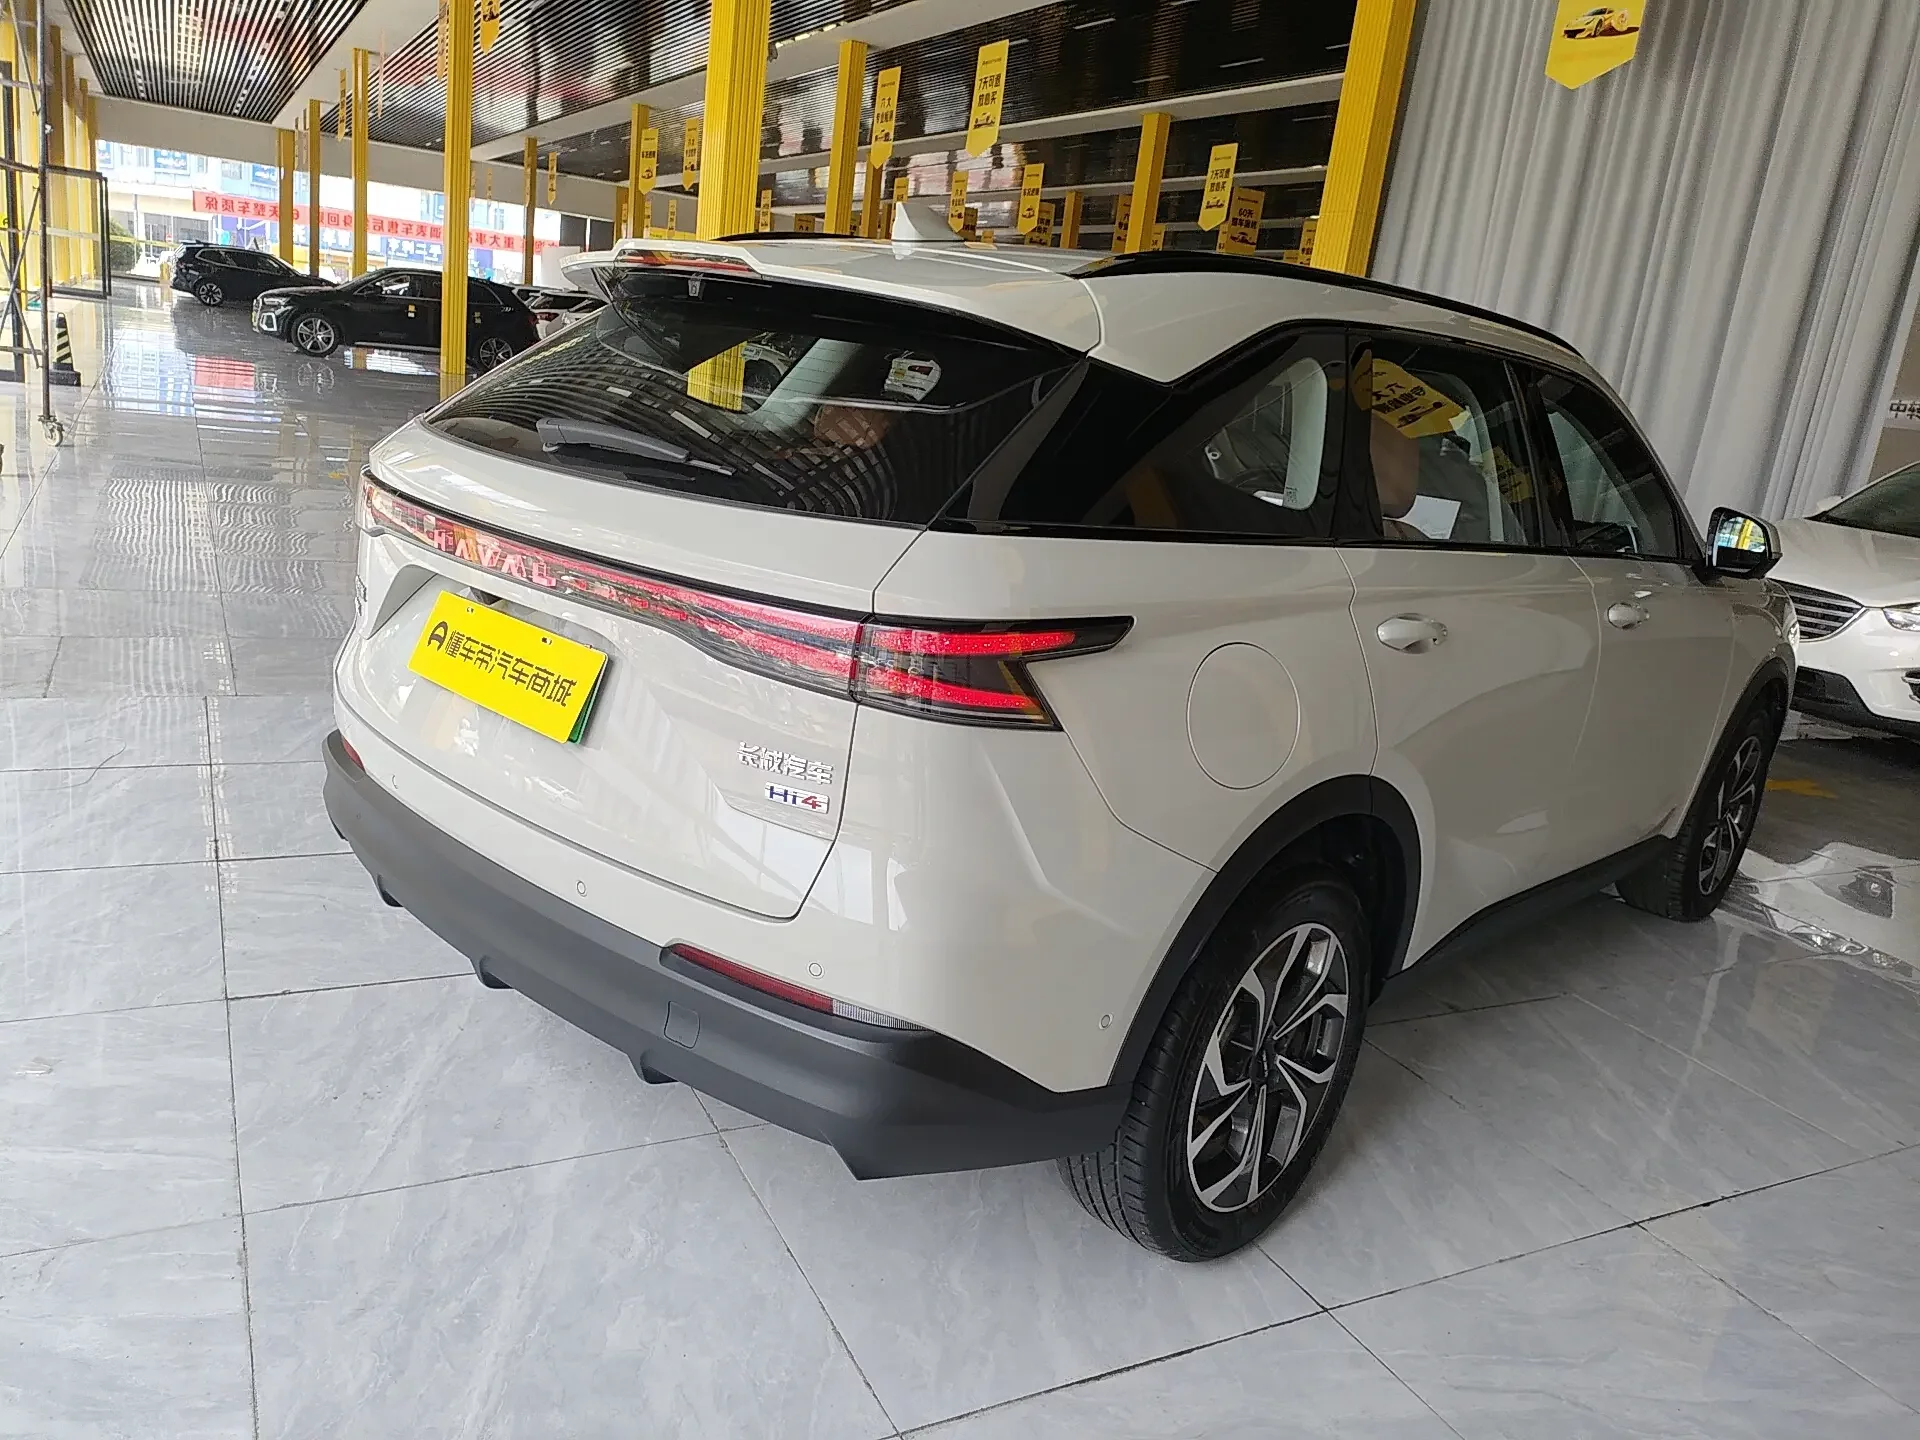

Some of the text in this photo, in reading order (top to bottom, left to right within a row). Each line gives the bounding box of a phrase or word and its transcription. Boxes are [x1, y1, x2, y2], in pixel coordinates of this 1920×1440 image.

[978, 73, 1001, 90] 7天可退
[433, 528, 558, 587] HAVAL
[444, 629, 578, 708] 懂车帝汽车商城
[736, 740, 835, 785] 长城汽车
[768, 785, 823, 811] Hi4
